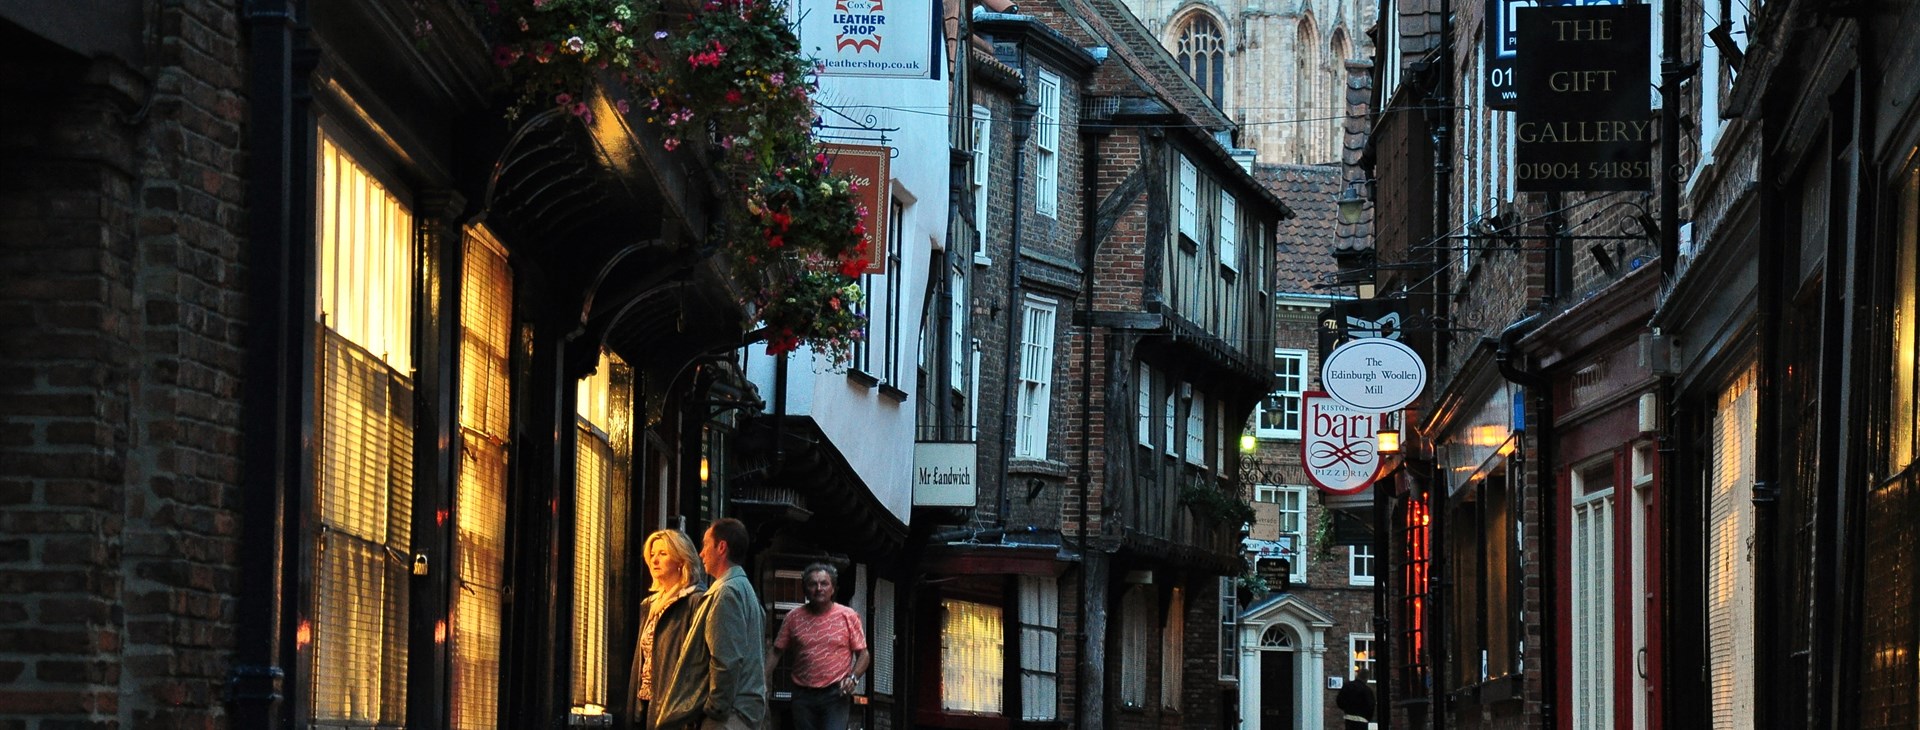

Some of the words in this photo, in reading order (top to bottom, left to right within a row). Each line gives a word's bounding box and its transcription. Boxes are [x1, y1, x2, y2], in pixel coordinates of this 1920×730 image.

[847, 1, 872, 9] Cox's
[833, 14, 886, 25] LEATHER
[842, 25, 876, 35] SHOP
[1551, 19, 1613, 42] THE
[1549, 70, 1617, 92] GIFT
[1517, 120, 1649, 143] GALLERY
[1517, 162, 1580, 180] 01904
[1588, 161, 1650, 179] 541851
[1365, 357, 1383, 367] The
[1331, 370, 1377, 382] Edinburgh
[1381, 370, 1417, 380] Woollen
[1364, 385, 1384, 395] Mill
[1311, 403, 1376, 439] bari
[918, 467, 931, 485] Mr
[1315, 469, 1369, 478] PIZZERIA
